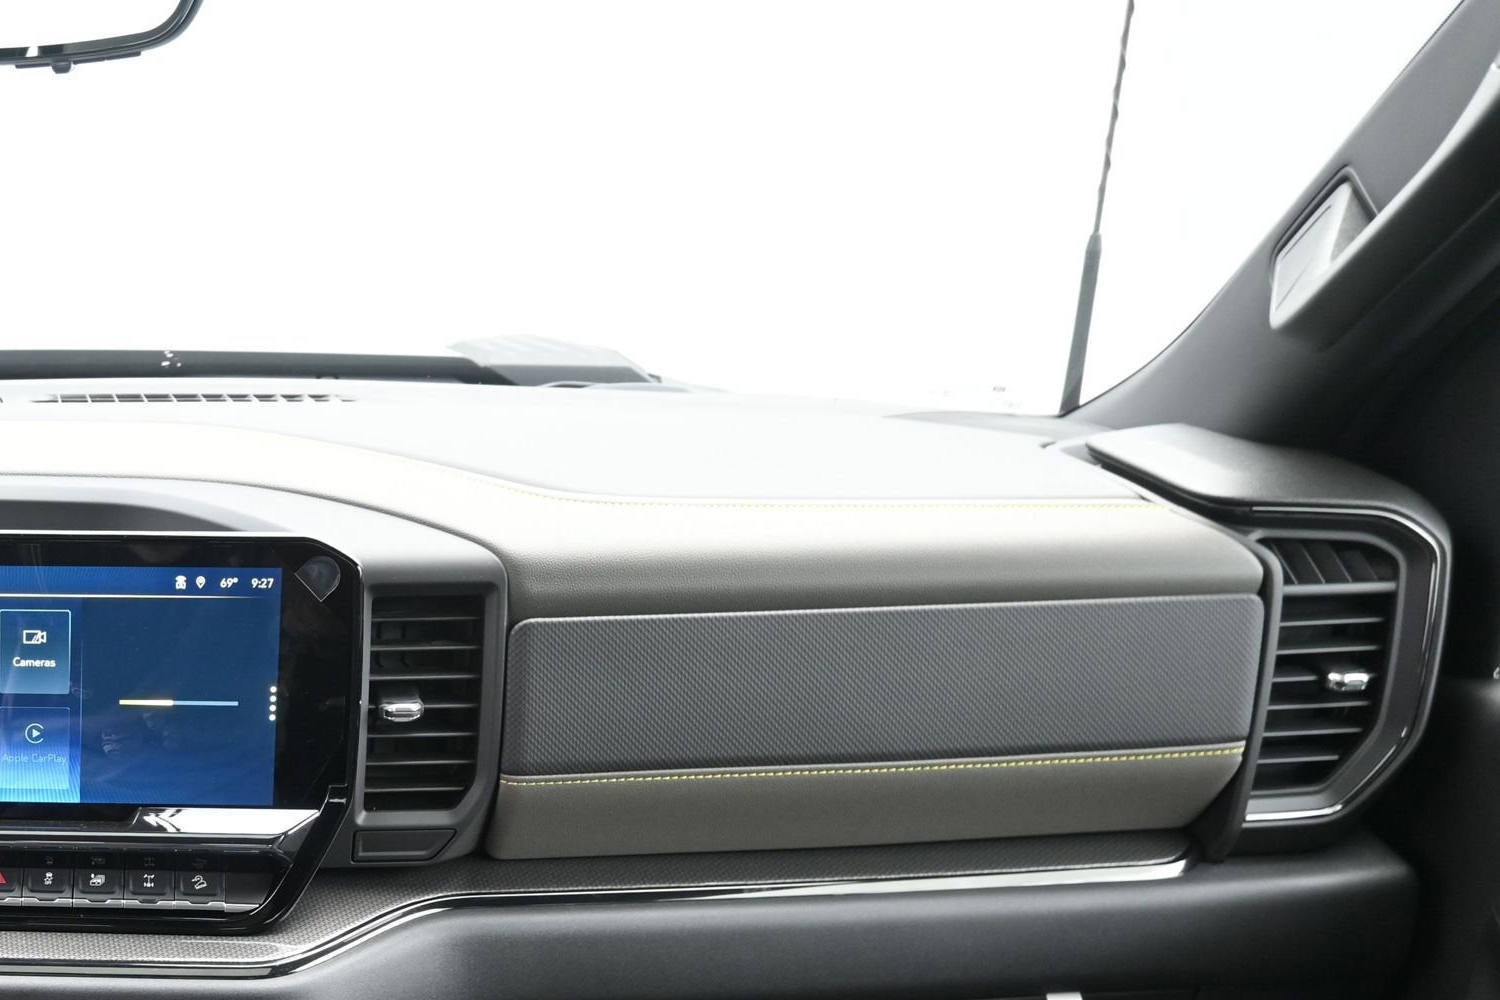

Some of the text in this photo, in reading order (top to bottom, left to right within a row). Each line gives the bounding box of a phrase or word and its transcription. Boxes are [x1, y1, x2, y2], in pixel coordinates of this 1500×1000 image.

[220, 578, 274, 588] 69° 9:27
[13, 657, 56, 667] Cameras
[2, 754, 66, 764] Apple CarPlay
